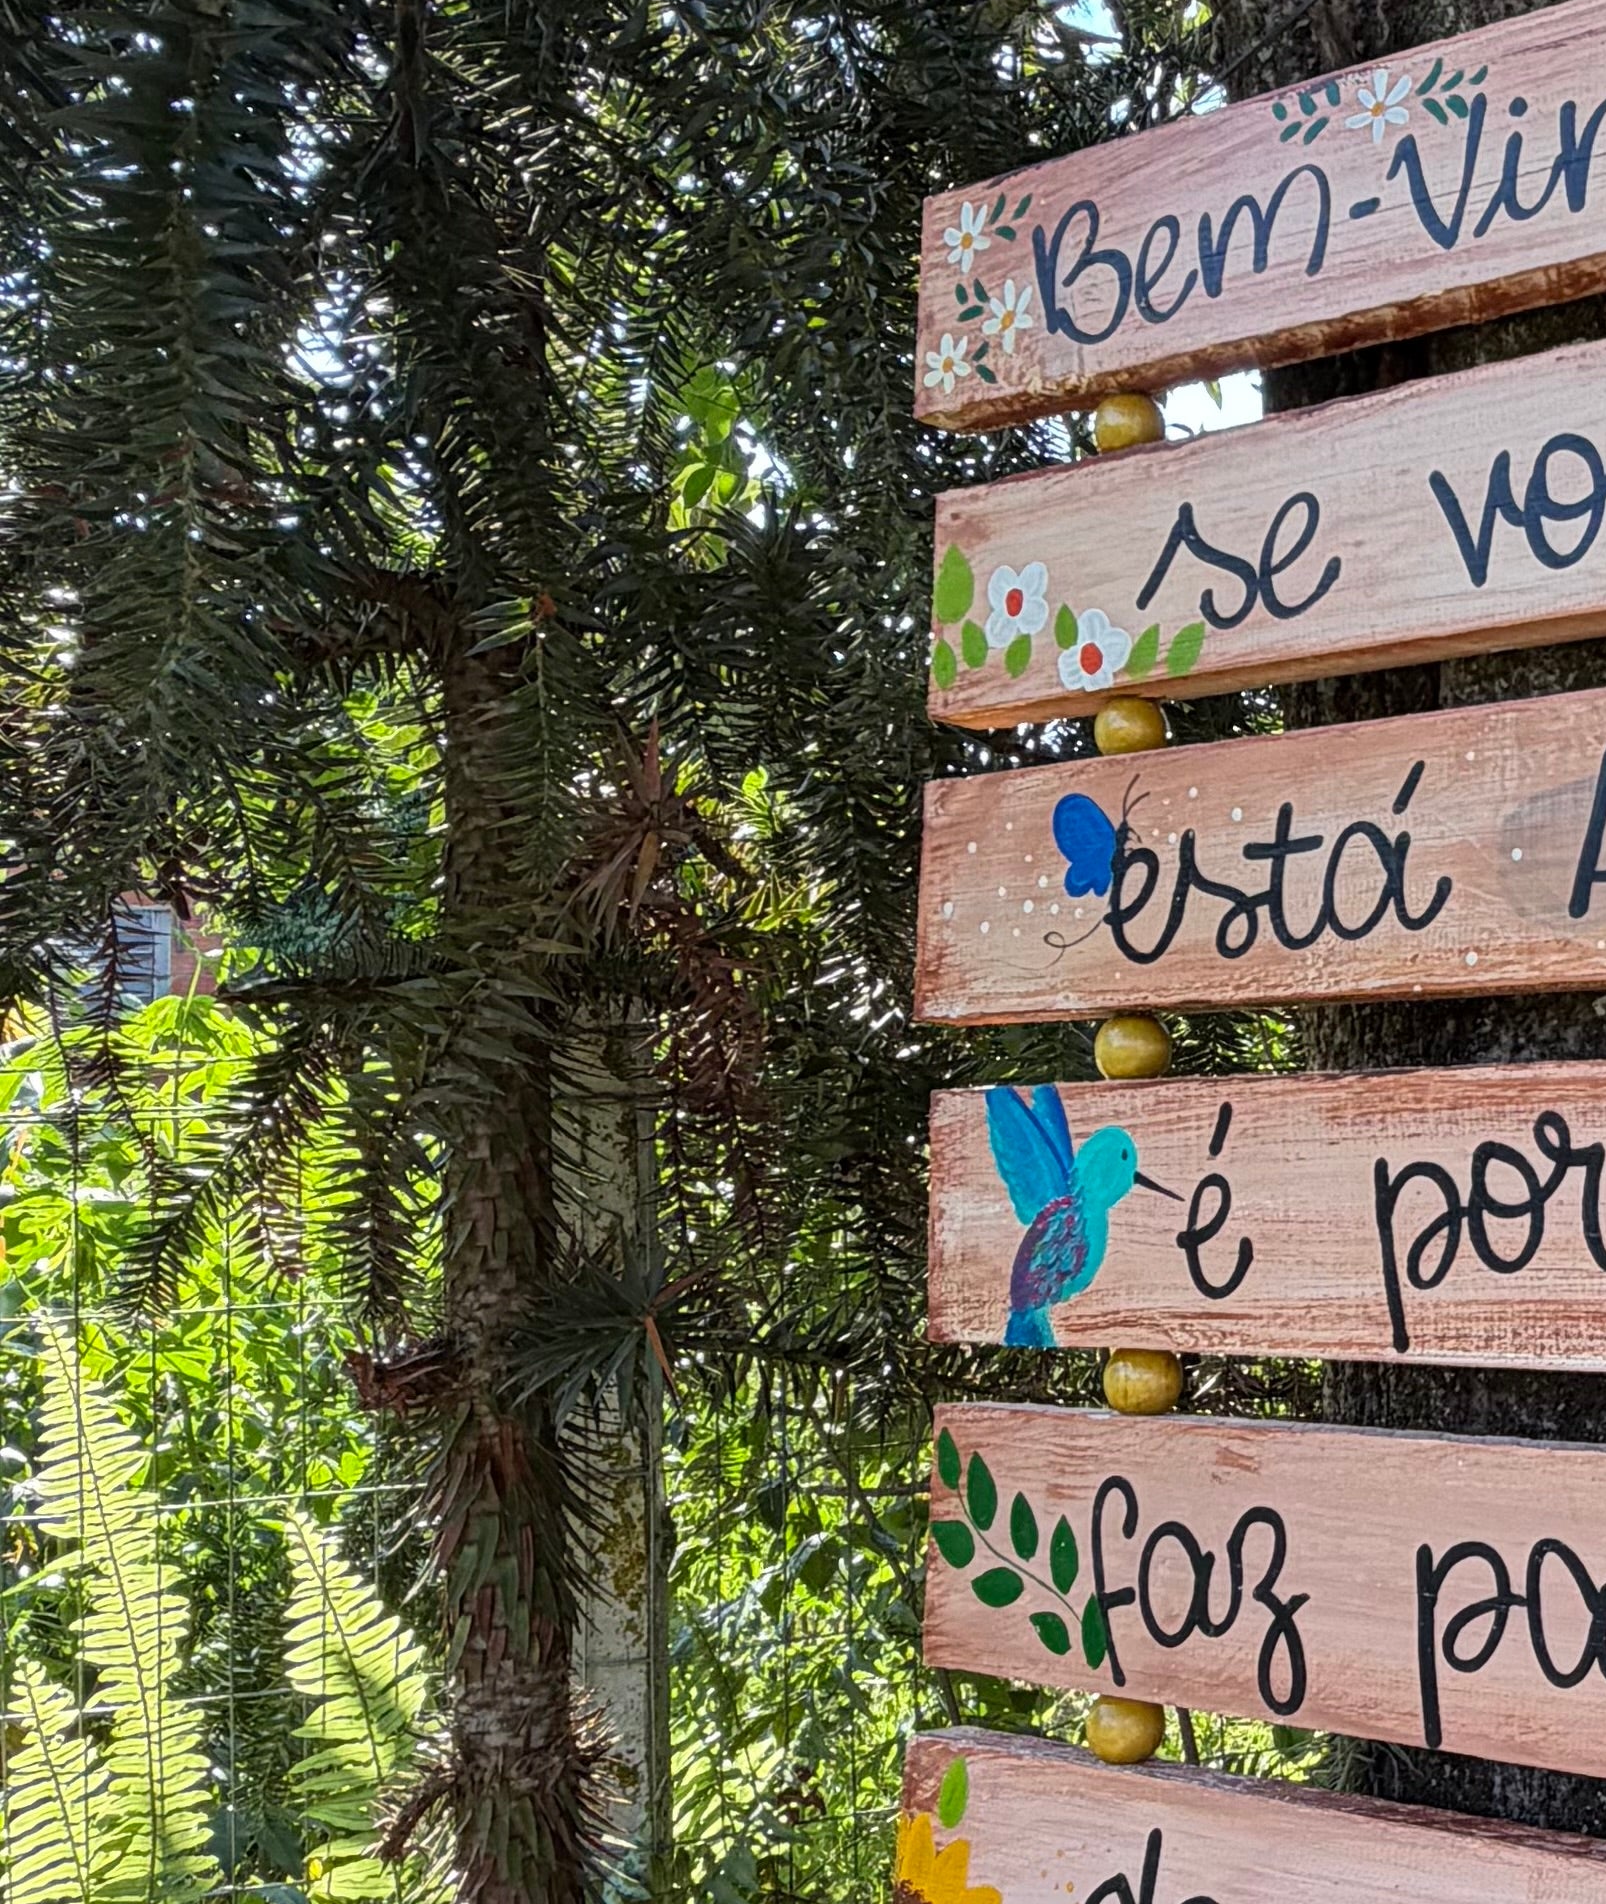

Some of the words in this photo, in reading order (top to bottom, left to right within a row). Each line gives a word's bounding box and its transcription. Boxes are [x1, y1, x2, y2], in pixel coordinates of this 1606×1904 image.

[1137, 491, 1341, 630] se
[1103, 760, 1453, 965] está
[1176, 1100, 1254, 1300] é
[1090, 1475, 1310, 1717] faz
